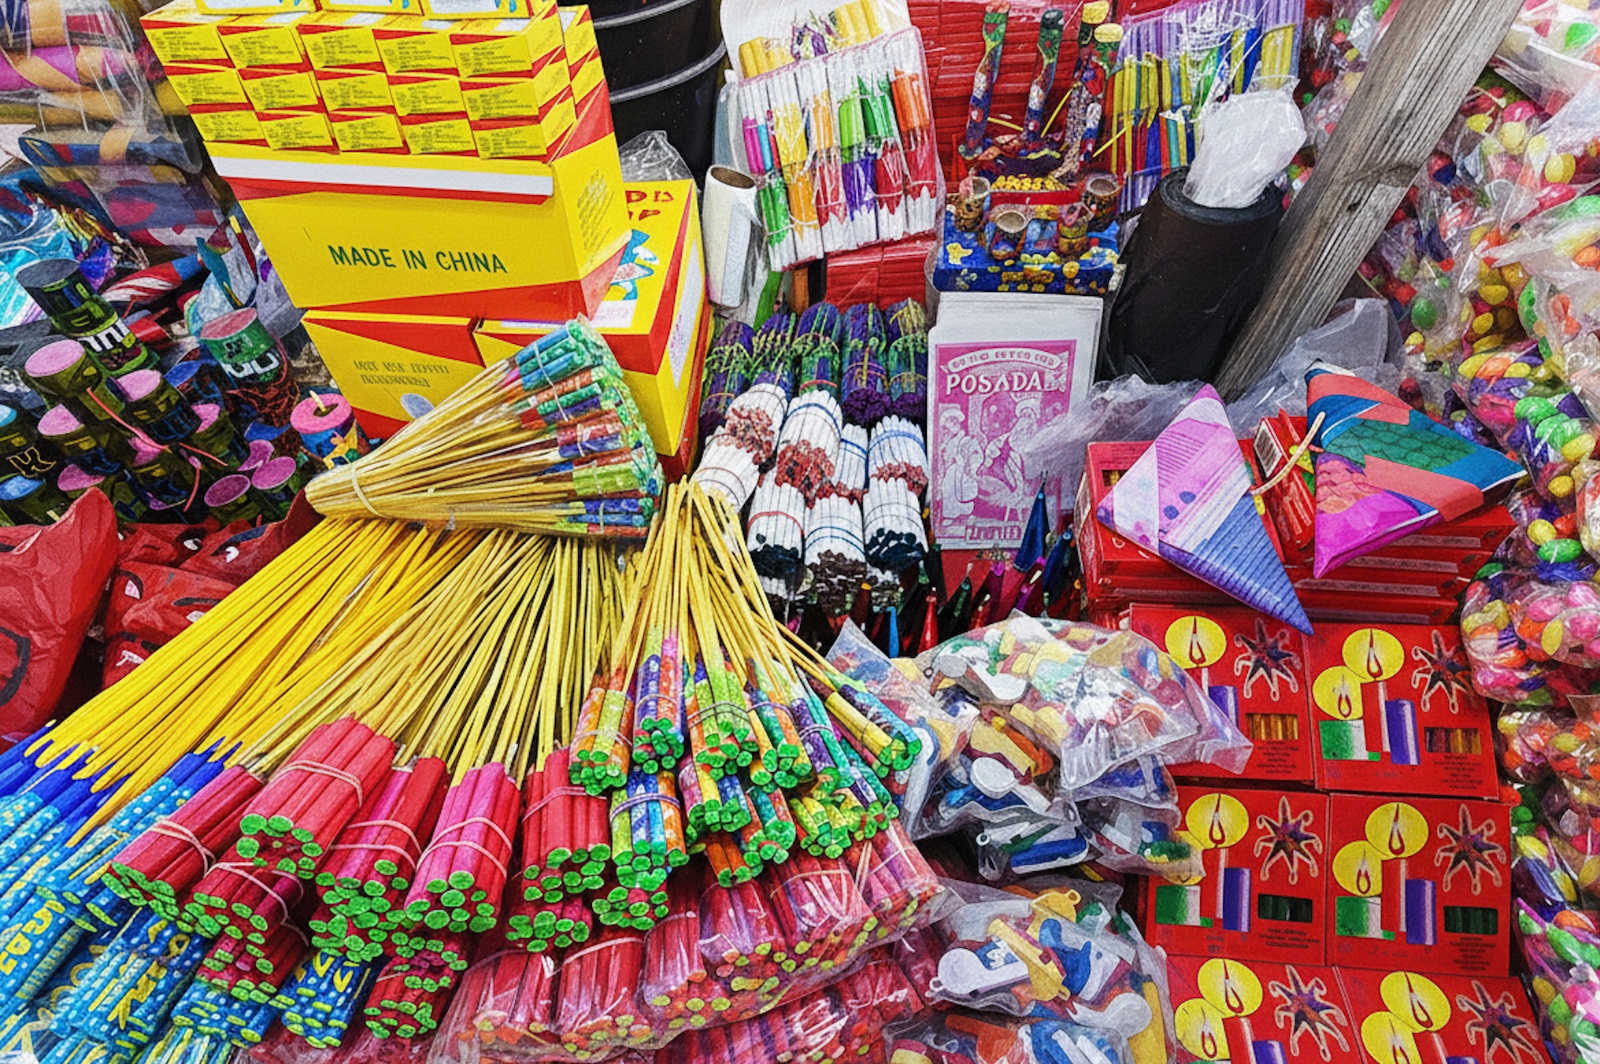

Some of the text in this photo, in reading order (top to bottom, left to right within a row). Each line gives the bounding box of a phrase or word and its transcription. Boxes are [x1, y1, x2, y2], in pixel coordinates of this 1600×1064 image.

[327, 245, 508, 274] MADE IN CHINA
[946, 370, 1043, 396] POSADA
